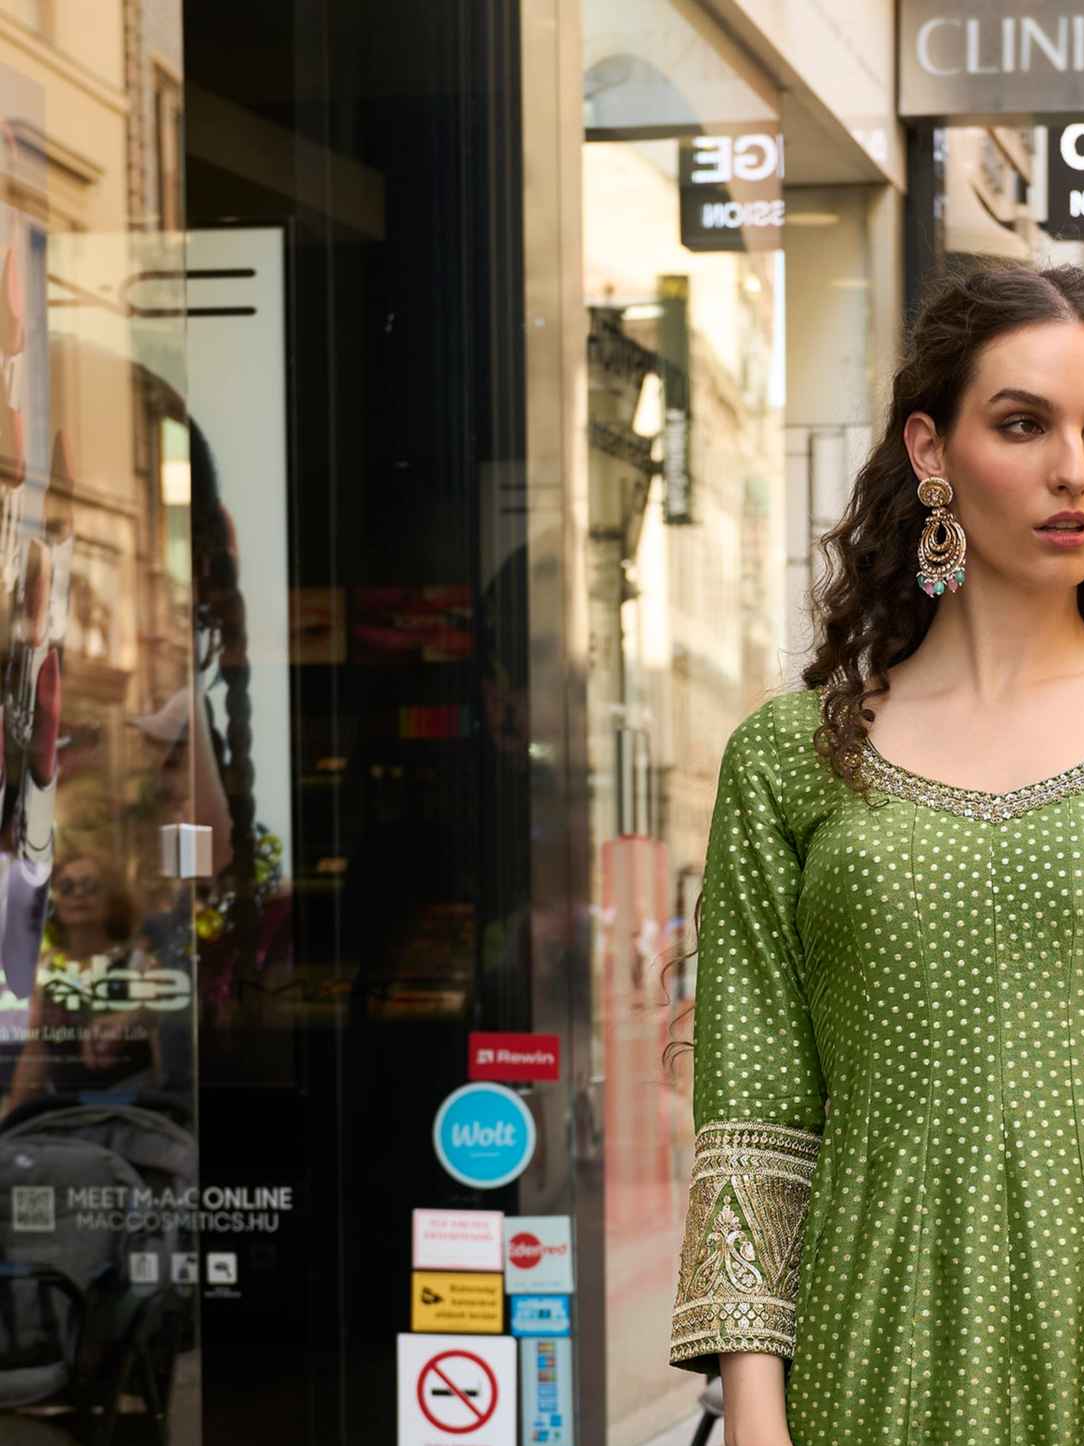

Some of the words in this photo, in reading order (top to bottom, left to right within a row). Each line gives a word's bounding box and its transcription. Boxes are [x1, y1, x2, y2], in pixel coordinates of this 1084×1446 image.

[452, 1119, 516, 1148] Wolt
[67, 1187, 128, 1209] MEET
[202, 1186, 294, 1211] ONLINE
[76, 1211, 280, 1232] MACCOSMETICS.HU
